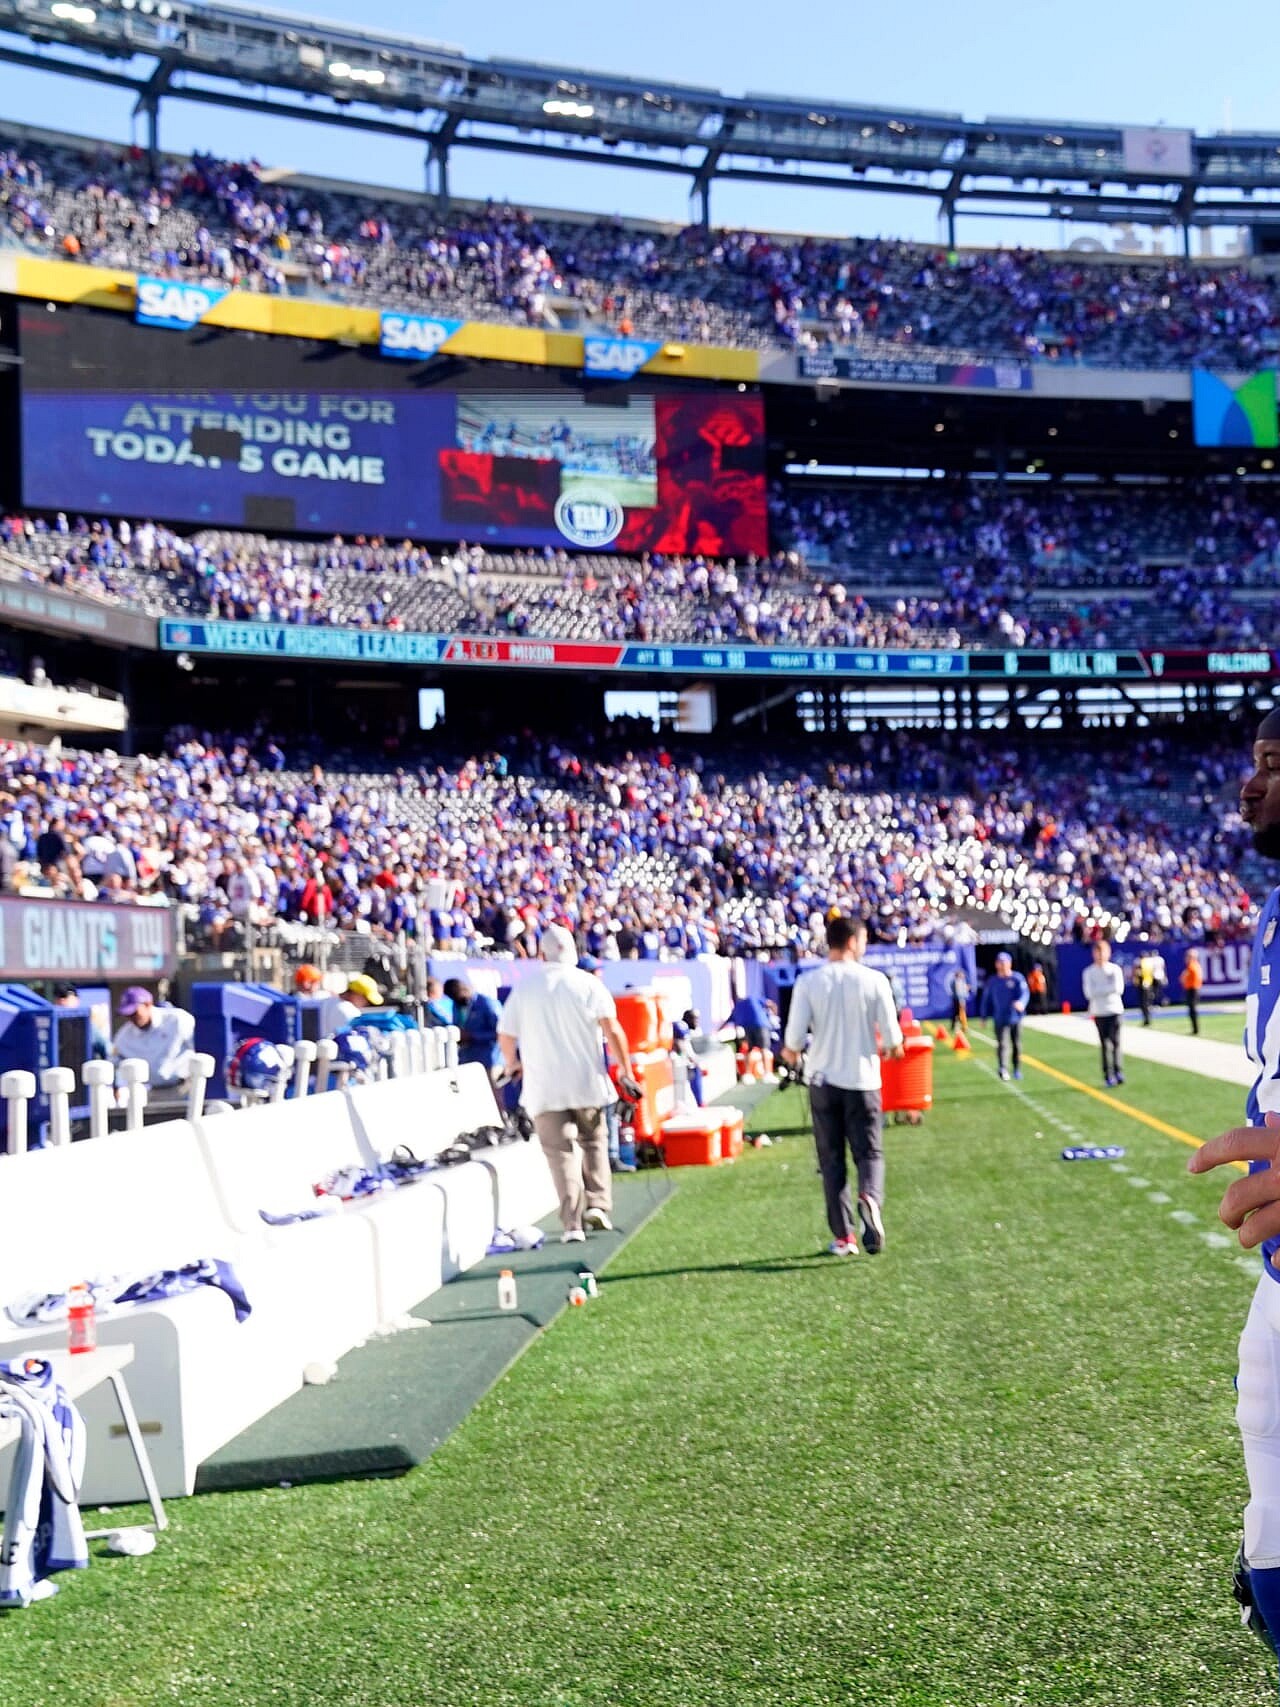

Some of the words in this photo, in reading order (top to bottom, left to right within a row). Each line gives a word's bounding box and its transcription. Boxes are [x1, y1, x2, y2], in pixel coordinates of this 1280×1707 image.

[138, 282, 210, 322] SAP
[382, 316, 447, 351] SAP
[584, 341, 647, 372] SAP
[123, 402, 351, 450] ATTENDING
[318, 394, 396, 425] FOR
[85, 427, 265, 474] TODAS
[271, 449, 386, 485] GAME
[203, 624, 282, 651] WEEKLY
[284, 630, 359, 656] RUSHING
[361, 635, 438, 661] LEADERS
[22, 905, 119, 970] GIANTS
